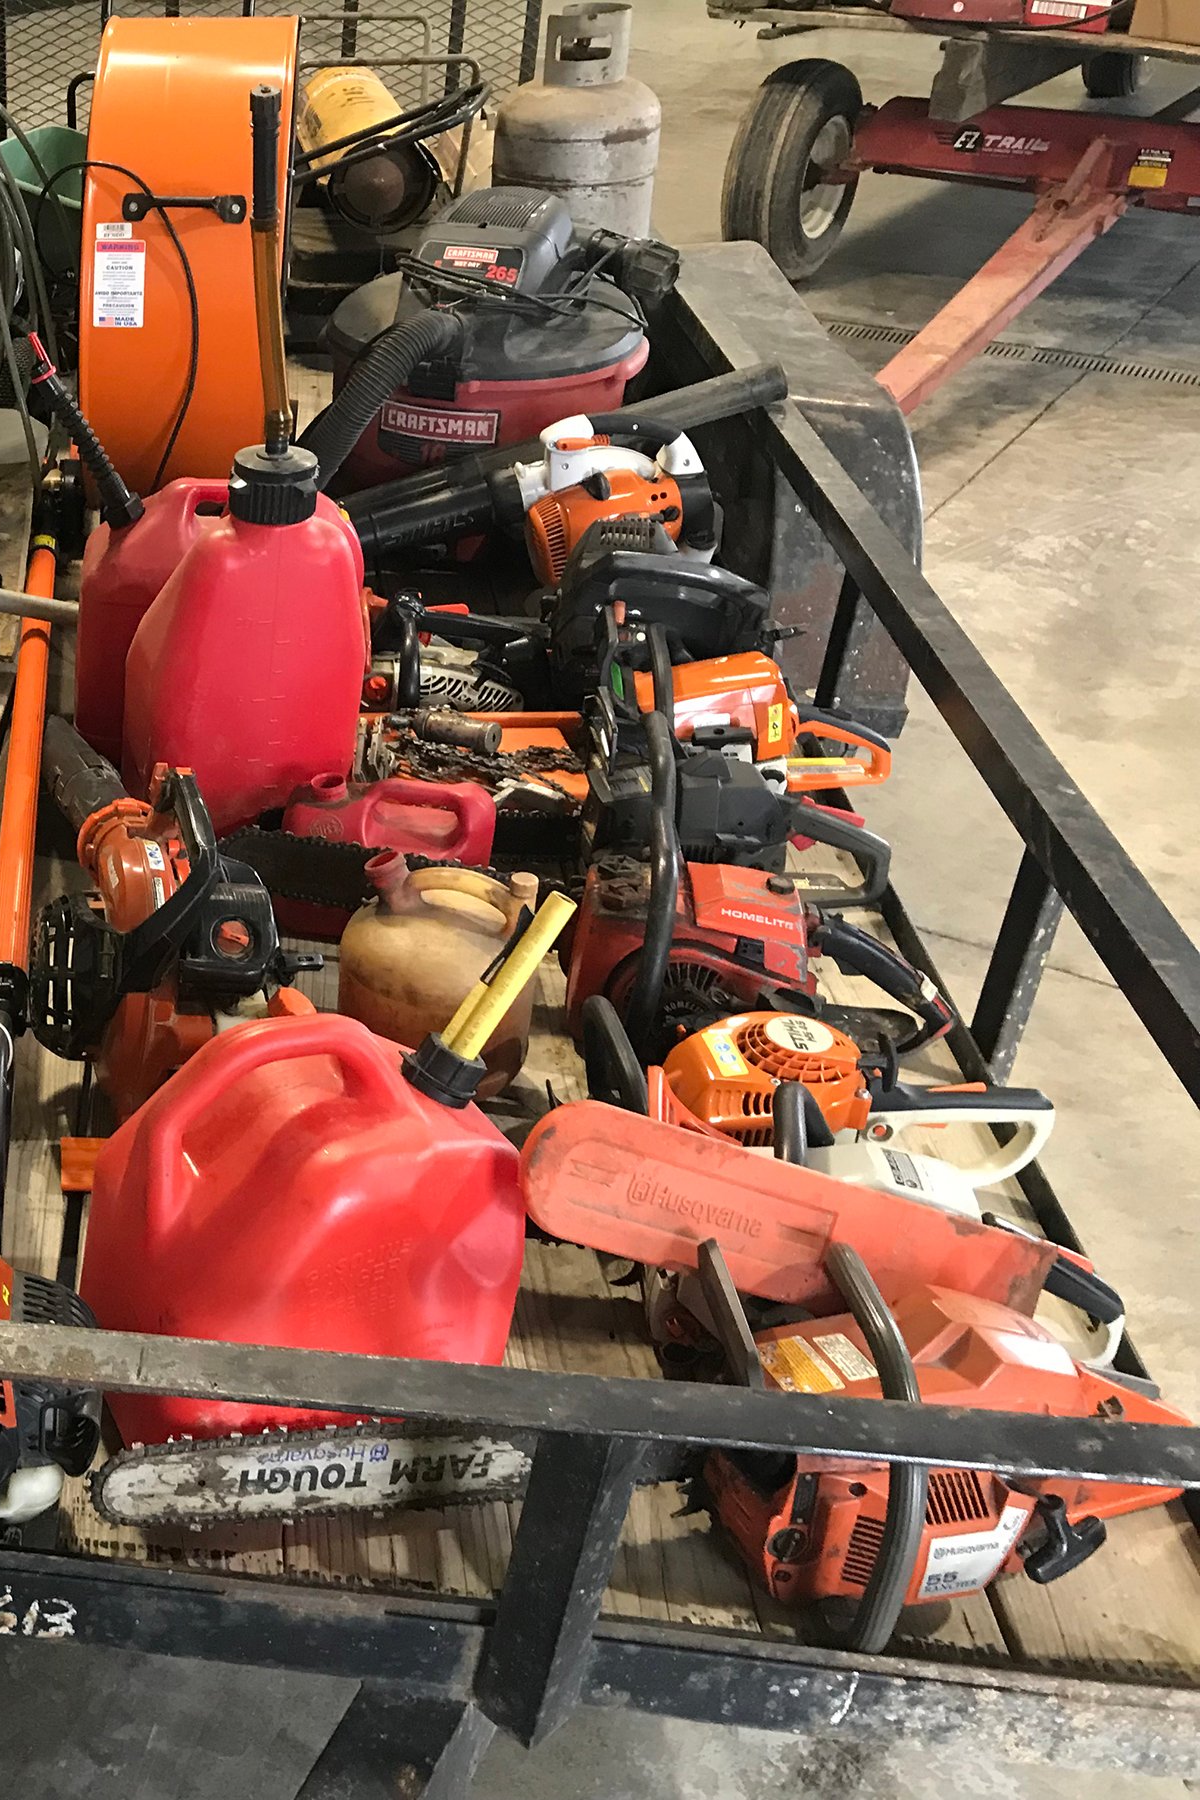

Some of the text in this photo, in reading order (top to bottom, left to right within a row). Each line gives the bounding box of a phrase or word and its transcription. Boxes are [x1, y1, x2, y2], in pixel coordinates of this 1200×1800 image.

[447, 248, 496, 260] CRAFTSMAN
[485, 264, 518, 283] 265
[388, 408, 490, 437] CRAFTSMAN
[720, 907, 795, 930] HOMELITE
[781, 1018, 810, 1051] STIHL
[650, 1182, 762, 1239] Husqvarna
[238, 1452, 492, 1494] FARM TOUGH
[926, 1571, 959, 1586] 55
